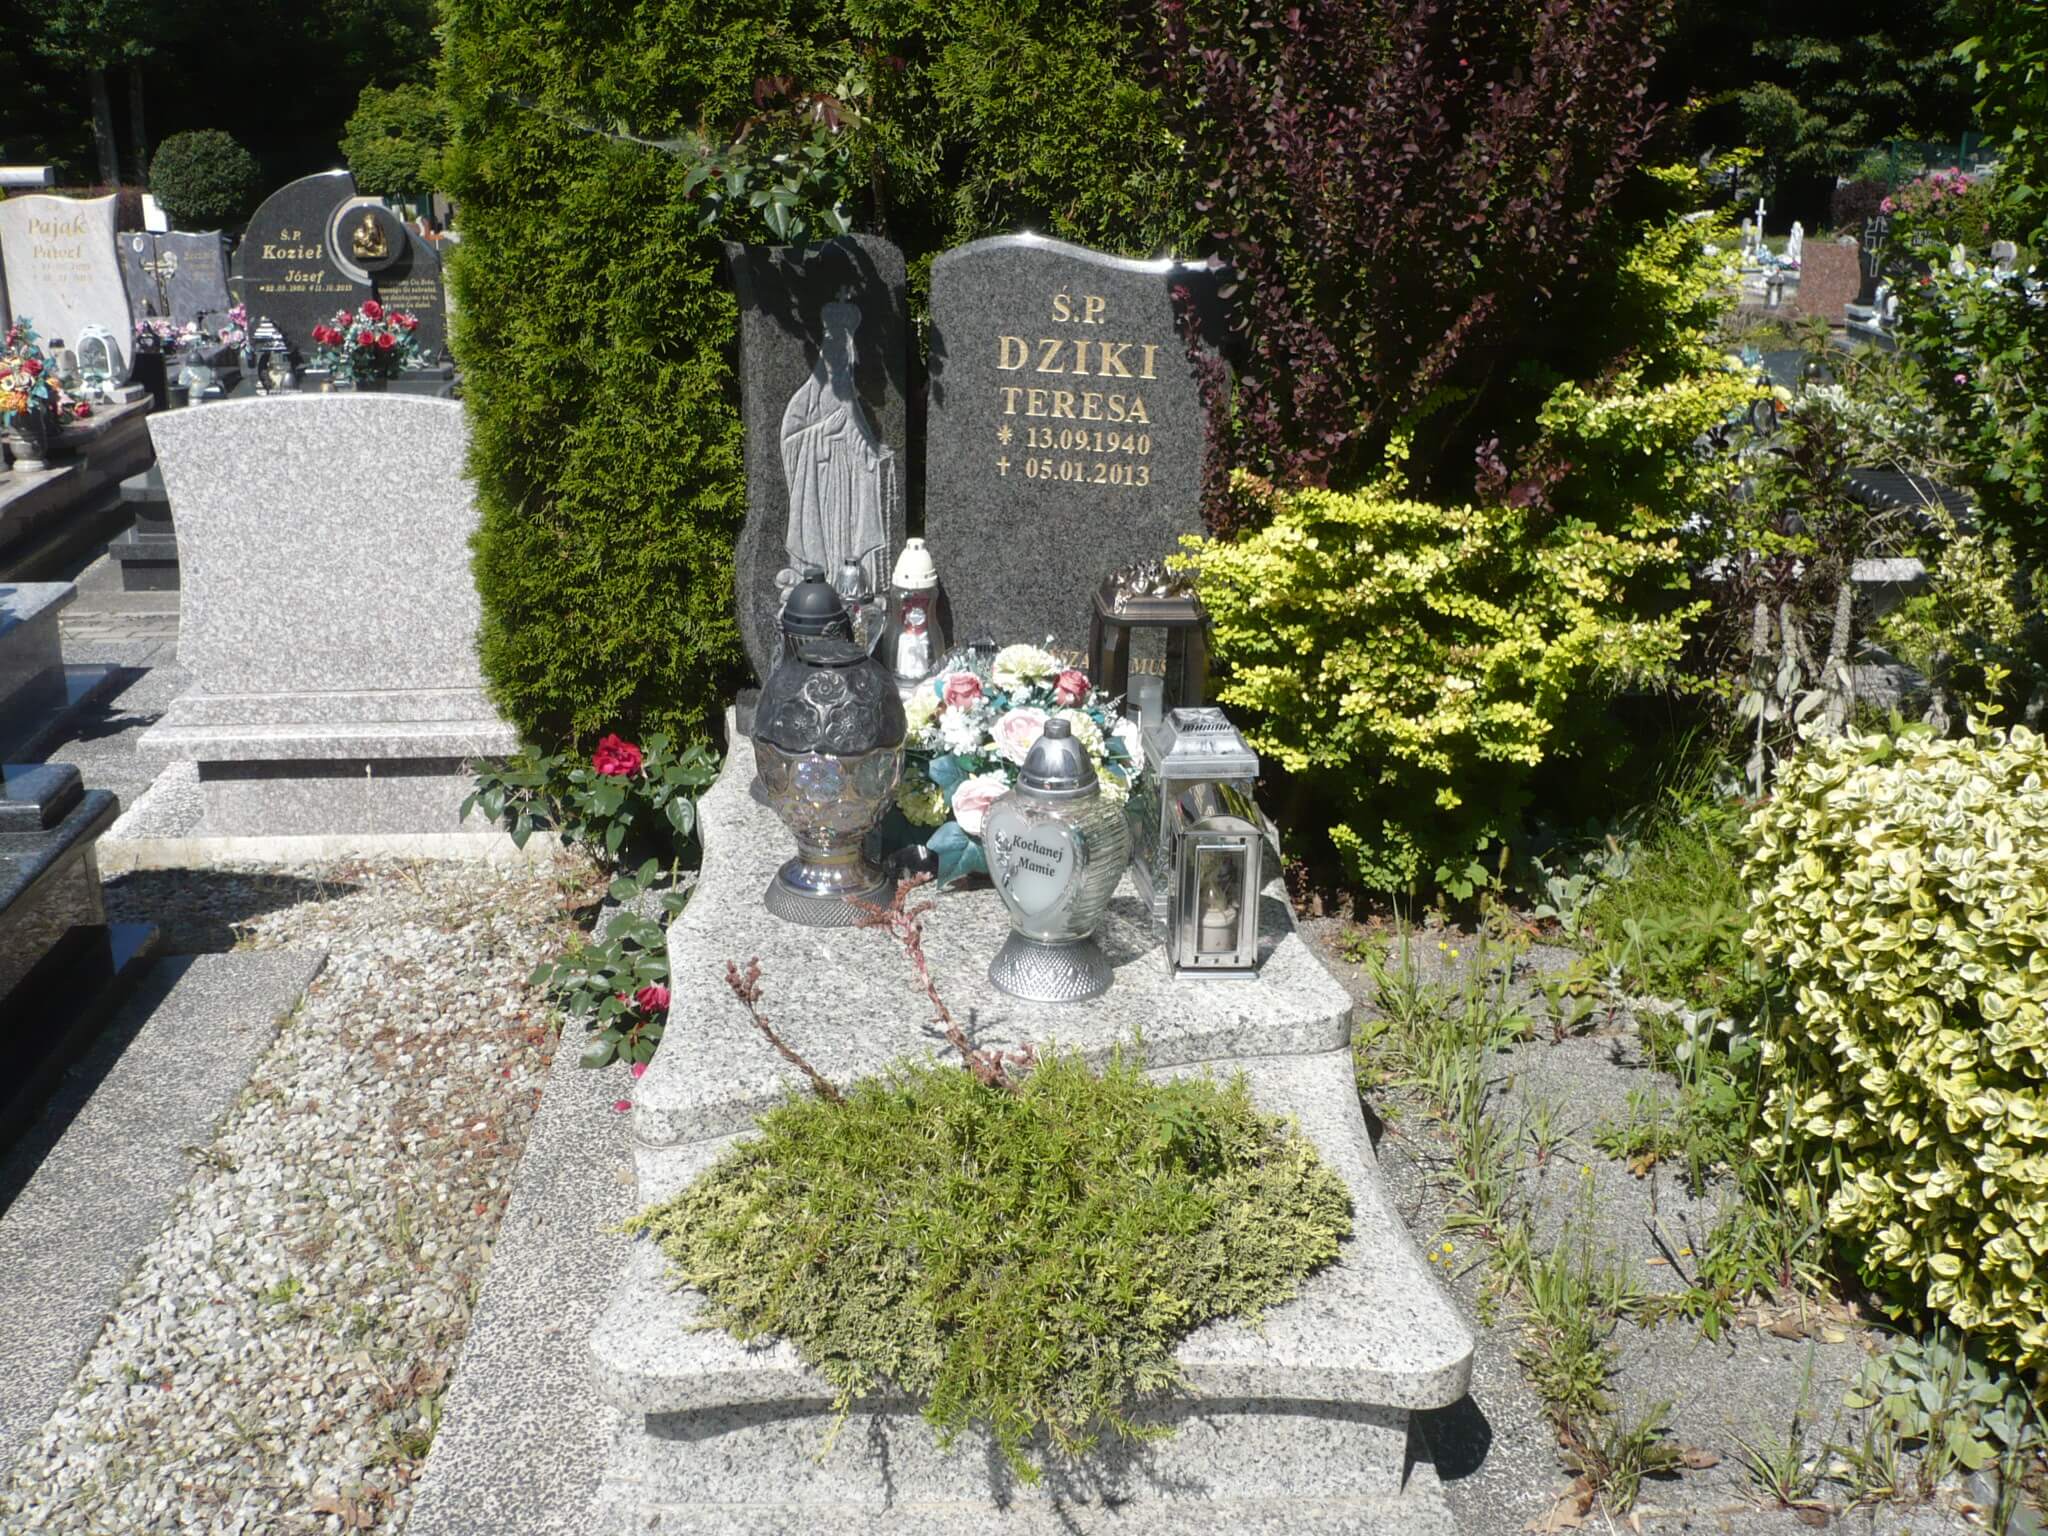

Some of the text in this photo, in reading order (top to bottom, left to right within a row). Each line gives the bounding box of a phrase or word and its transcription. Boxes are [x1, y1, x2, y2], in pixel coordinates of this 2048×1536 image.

[261, 244, 323, 260] Kozieł
[285, 270, 325, 284] Józef
[1052, 285, 1106, 325] Ś.P.
[996, 335, 1160, 380] DZIKI
[999, 386, 1151, 425] TERESA
[1026, 426, 1151, 456] 13.09.1940
[1024, 457, 1150, 487] 05.01.2013
[1012, 834, 1064, 863] Kochanej
[1018, 856, 1056, 877] Mamie
